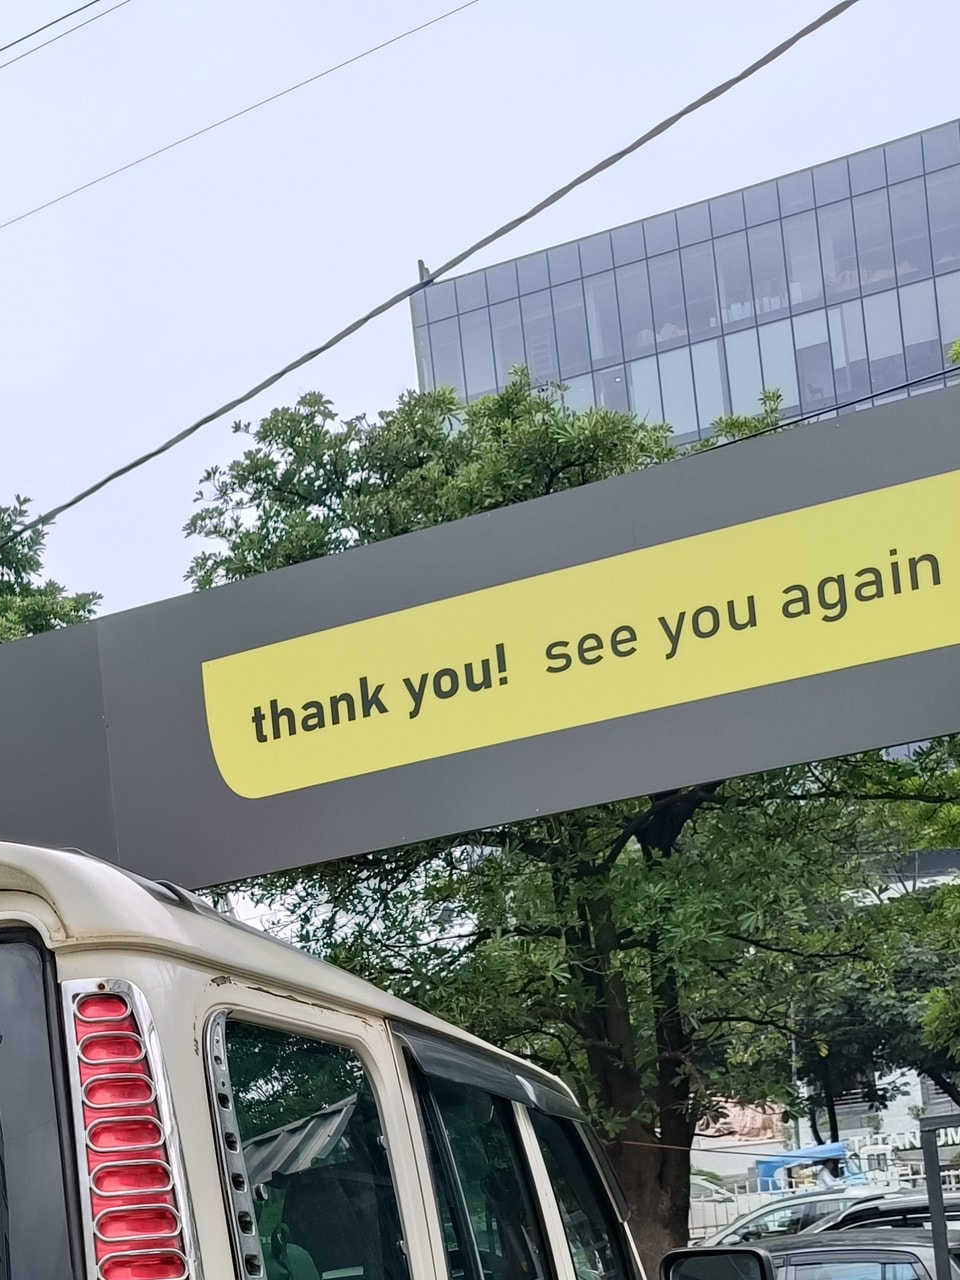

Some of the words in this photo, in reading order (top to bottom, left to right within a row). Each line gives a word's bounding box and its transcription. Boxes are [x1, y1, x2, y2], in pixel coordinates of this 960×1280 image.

[251, 676, 389, 744] thank
[402, 643, 510, 719] you!
[544, 623, 638, 674] see
[657, 595, 758, 660] you
[781, 549, 942, 622] again
